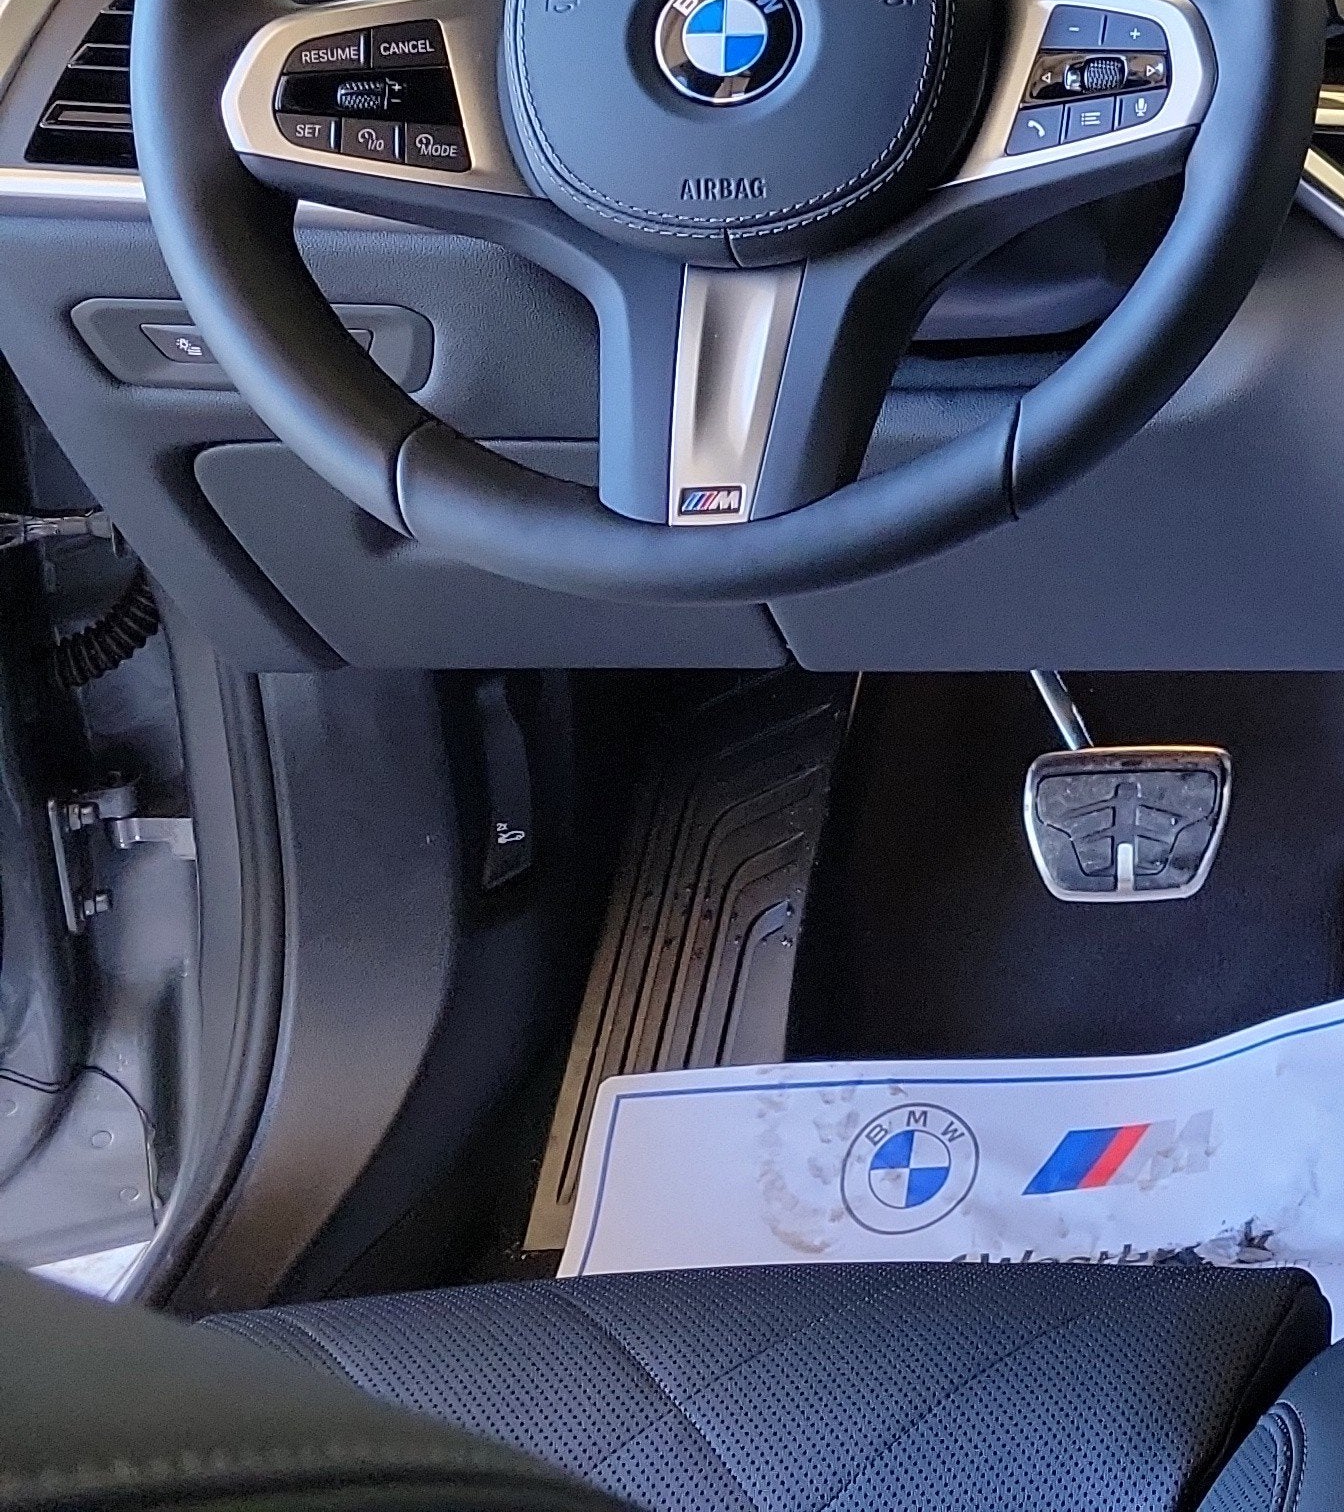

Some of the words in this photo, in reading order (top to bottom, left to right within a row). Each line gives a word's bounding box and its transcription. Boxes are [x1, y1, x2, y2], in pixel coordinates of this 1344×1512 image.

[301, 46, 359, 64] RESUME
[380, 39, 435, 56] CANCEL
[295, 124, 322, 138] SET
[420, 144, 458, 158] MODE
[681, 177, 767, 201] AIRBAG
[864, 1109, 966, 1147] BMW
